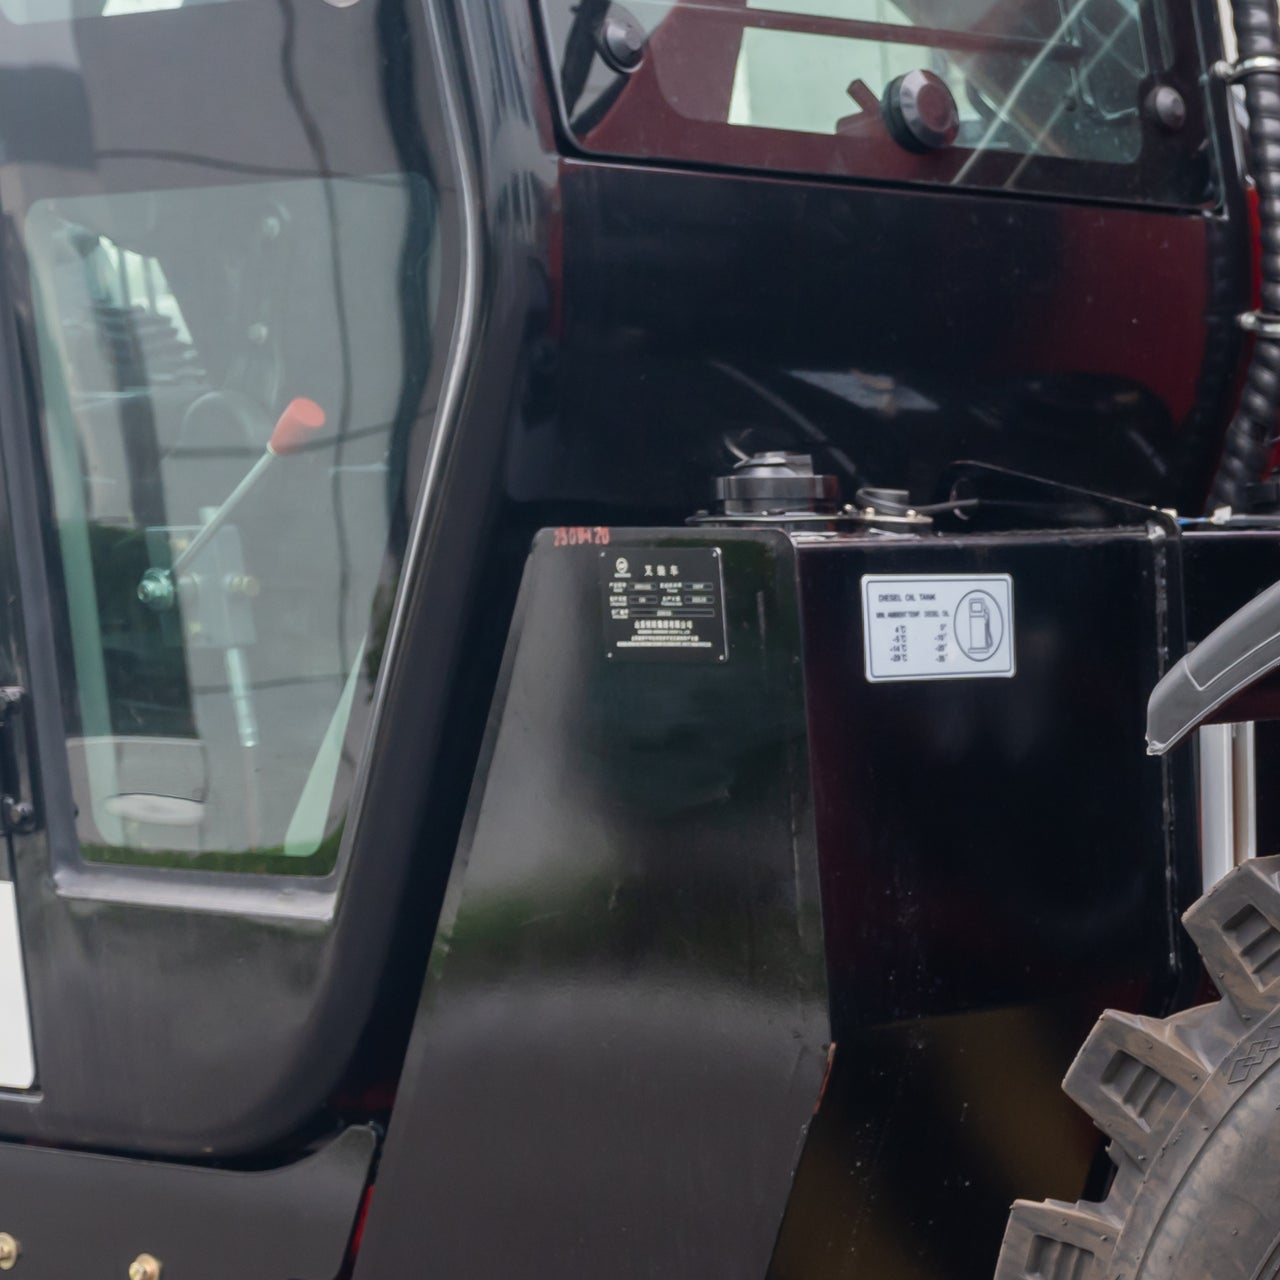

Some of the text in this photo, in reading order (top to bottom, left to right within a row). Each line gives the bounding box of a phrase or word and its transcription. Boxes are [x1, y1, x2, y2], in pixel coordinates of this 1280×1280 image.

[878, 592, 936, 602] DIESEL OIL TANK
